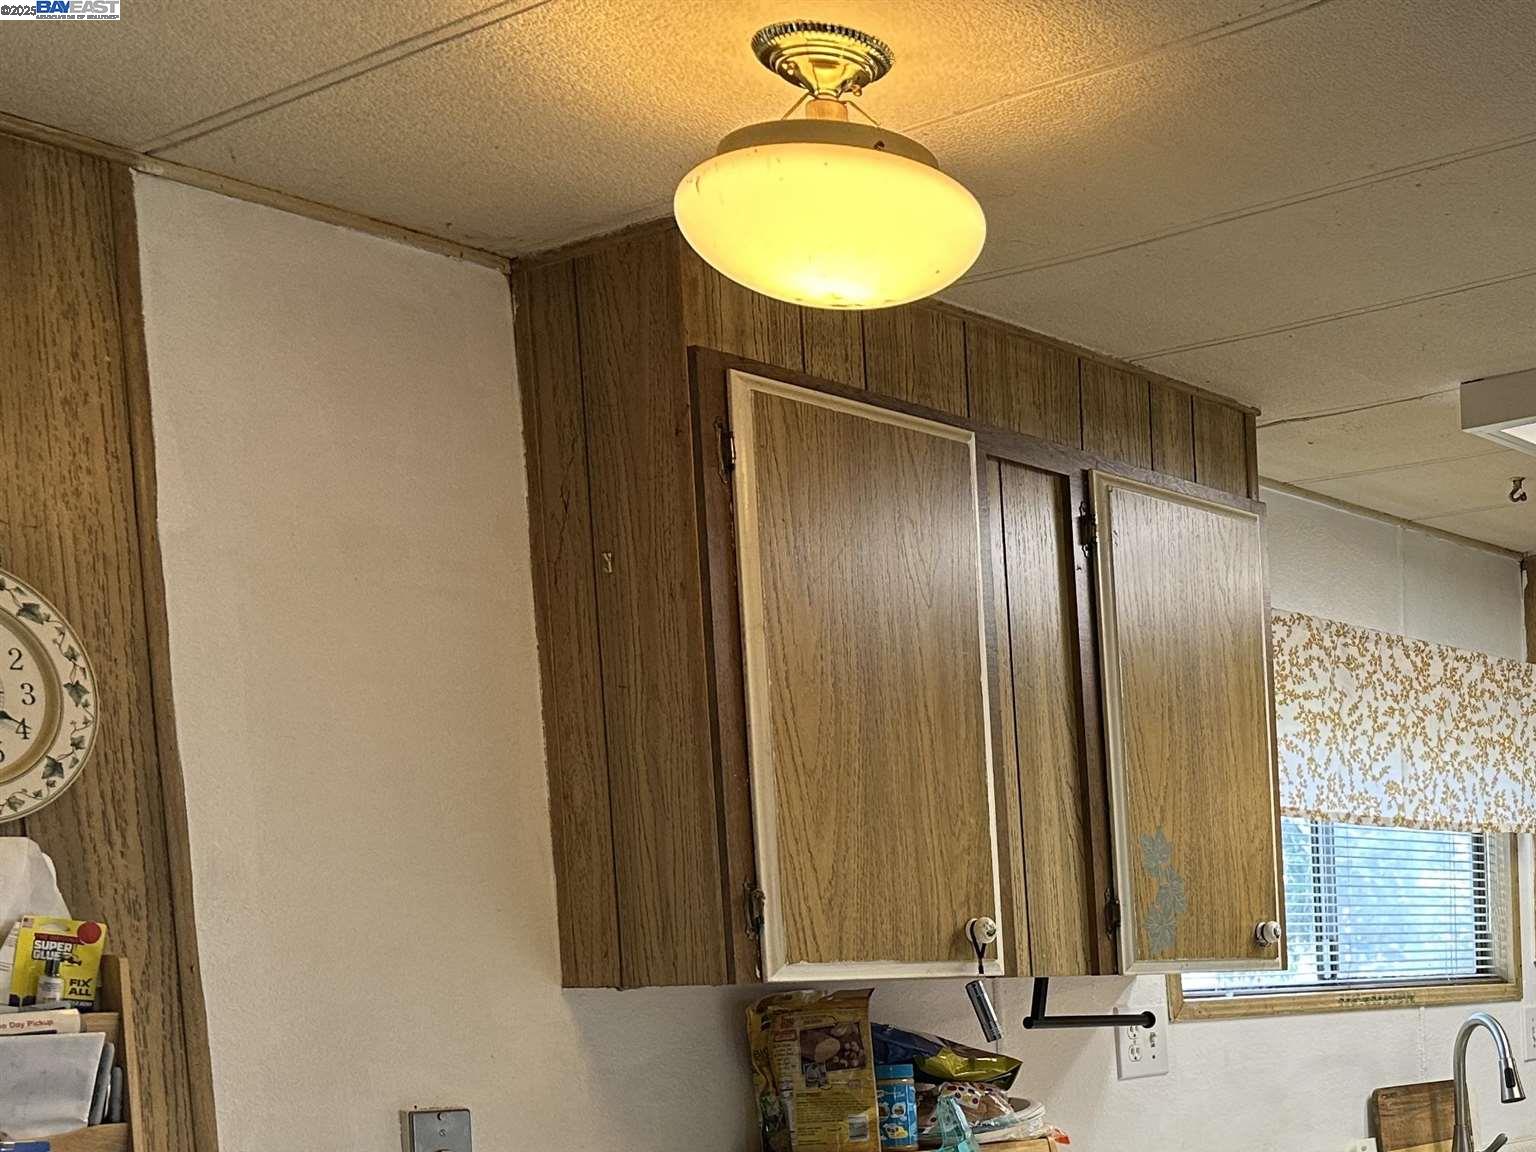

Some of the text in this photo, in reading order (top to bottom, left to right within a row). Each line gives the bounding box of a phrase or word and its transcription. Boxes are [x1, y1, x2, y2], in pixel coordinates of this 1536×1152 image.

[8, 647, 24, 670] 2
[20, 682, 36, 705] 3
[15, 718, 31, 739] 4
[34, 940, 73, 952] SUPER
[33, 950, 63, 960] GLUE
[69, 978, 92, 988] FIX
[68, 988, 92, 996] ALL
[9, 1021, 25, 1029] Day
[27, 1019, 53, 1028] Pickup
